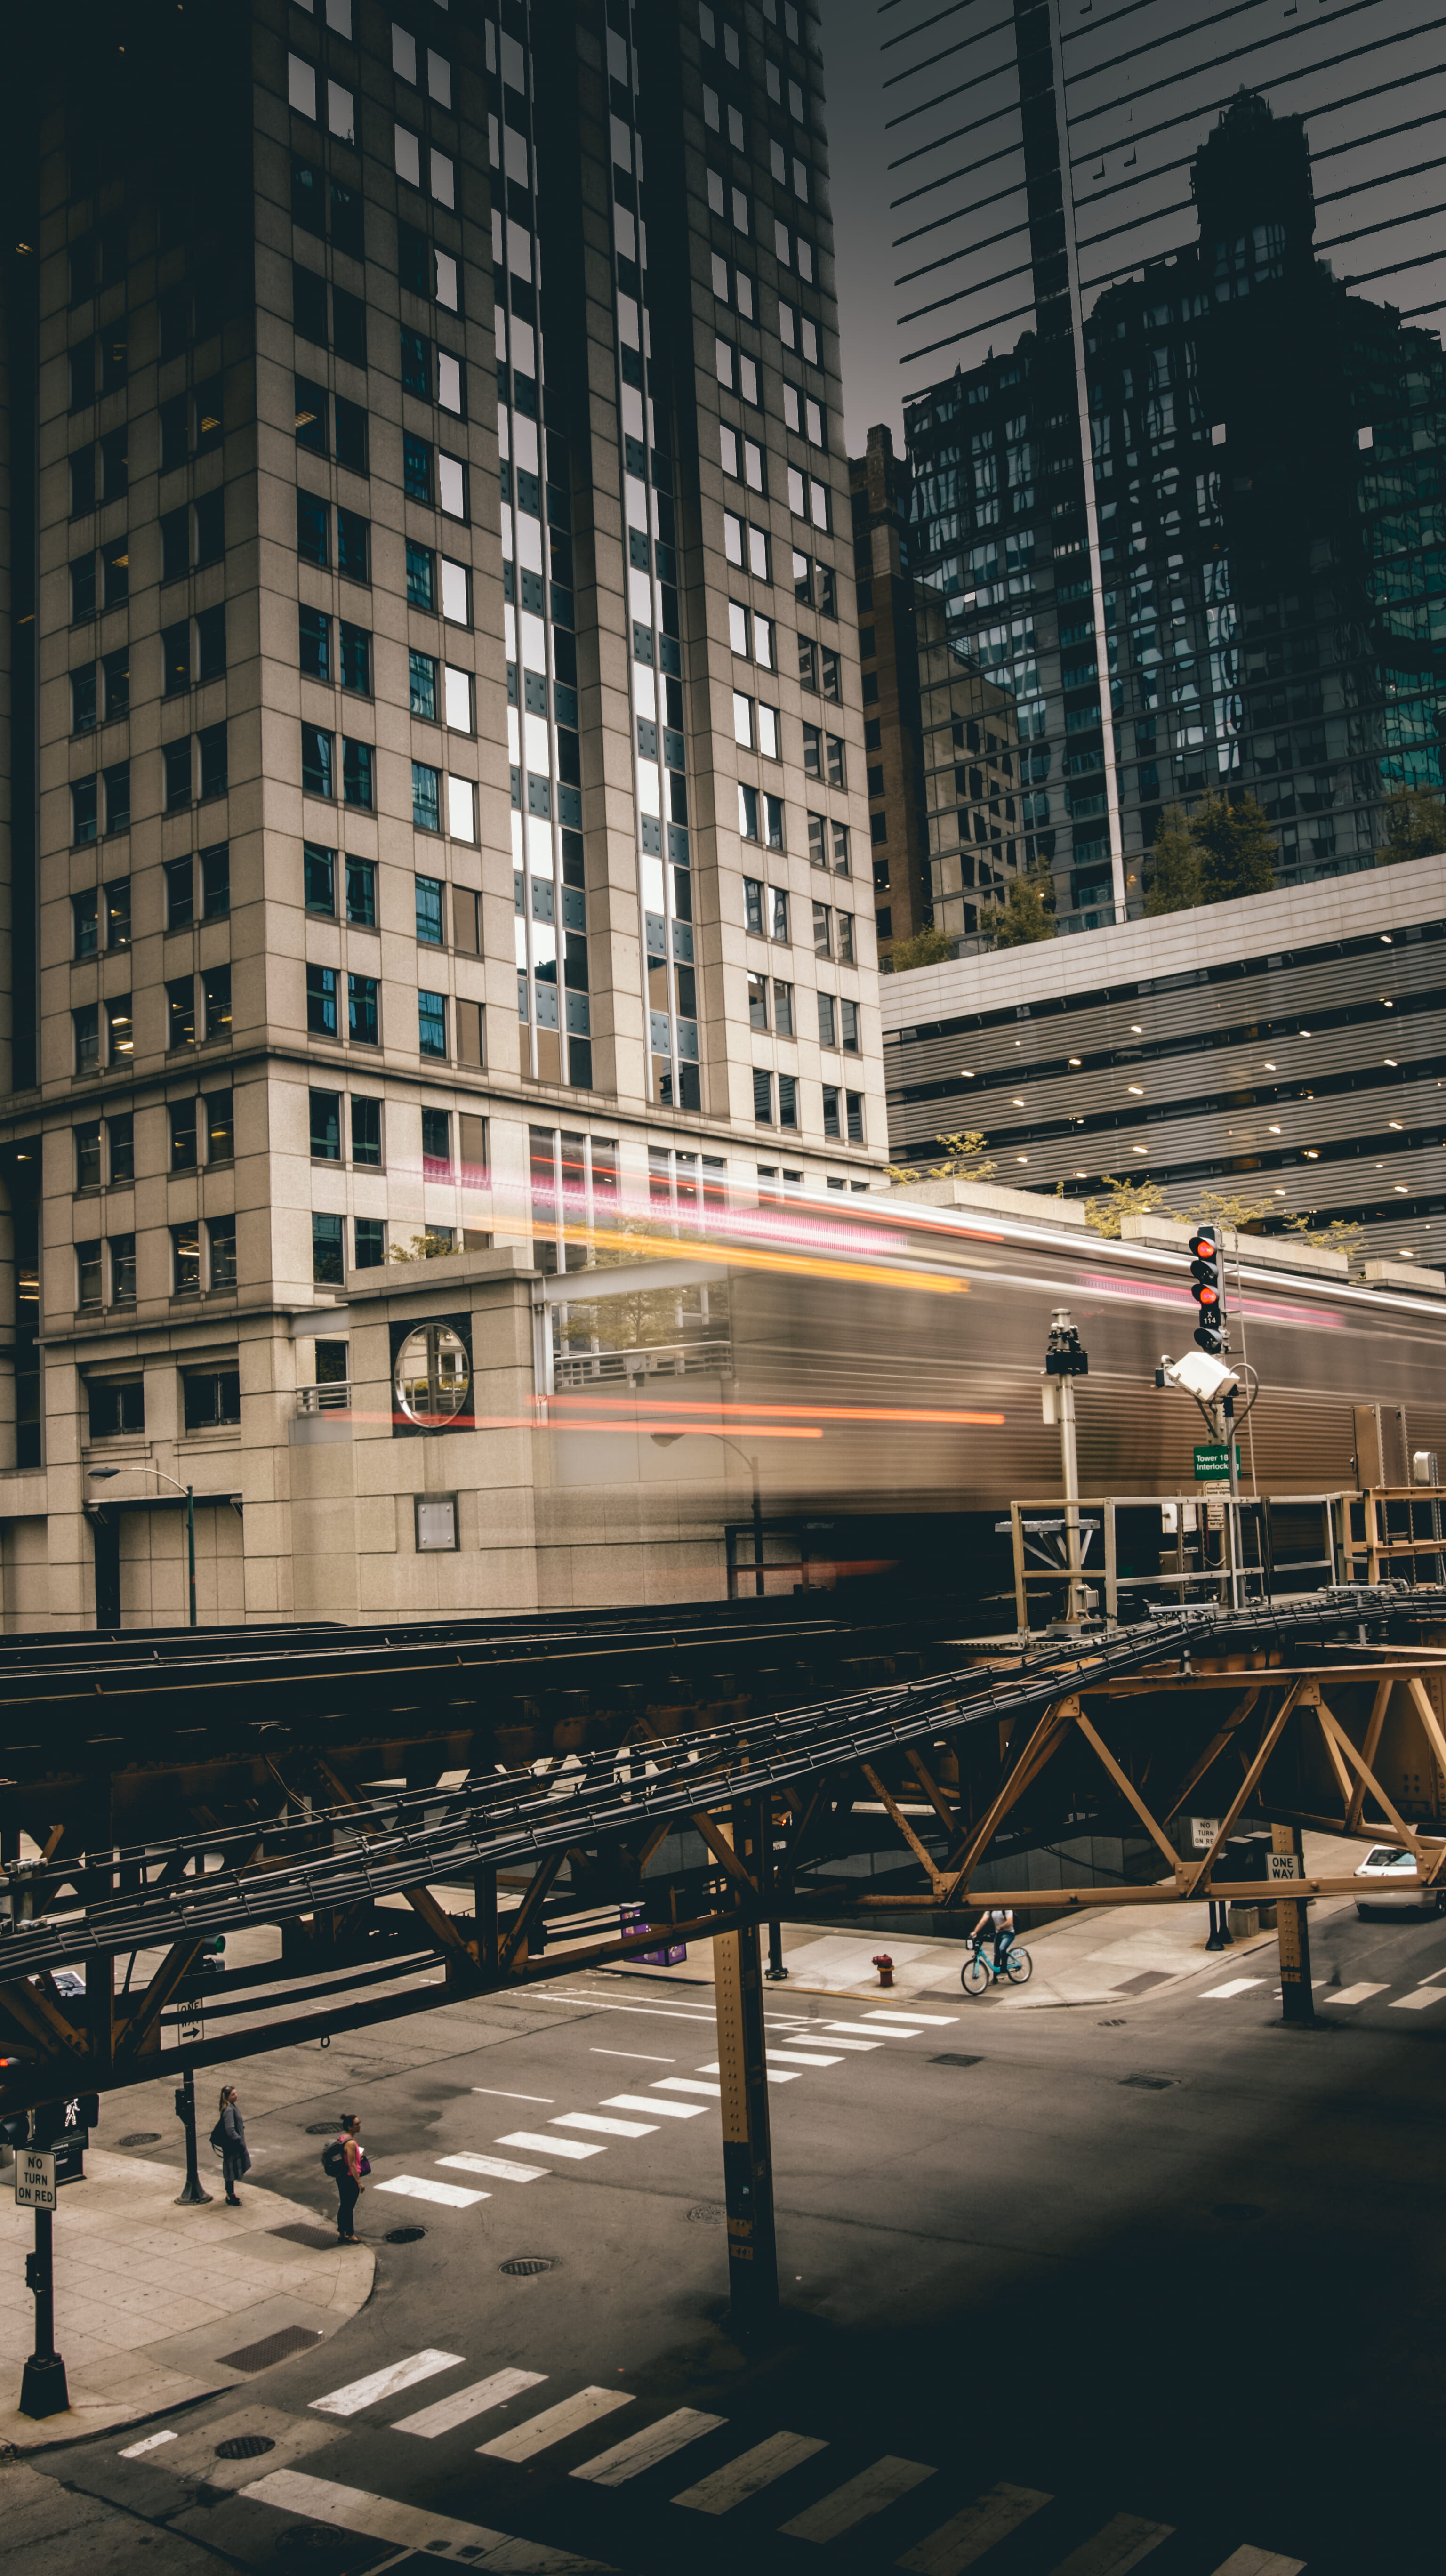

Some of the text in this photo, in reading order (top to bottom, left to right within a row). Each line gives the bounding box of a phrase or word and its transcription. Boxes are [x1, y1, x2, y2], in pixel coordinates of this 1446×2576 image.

[1197, 1463, 1239, 1471] Interlockg
[1272, 1857, 1293, 1868] ONE
[1272, 1868, 1294, 1879] WAY
[28, 2157, 43, 2169] NO
[24, 2172, 48, 2186] TURN
[19, 2187, 53, 2202] ON RED
